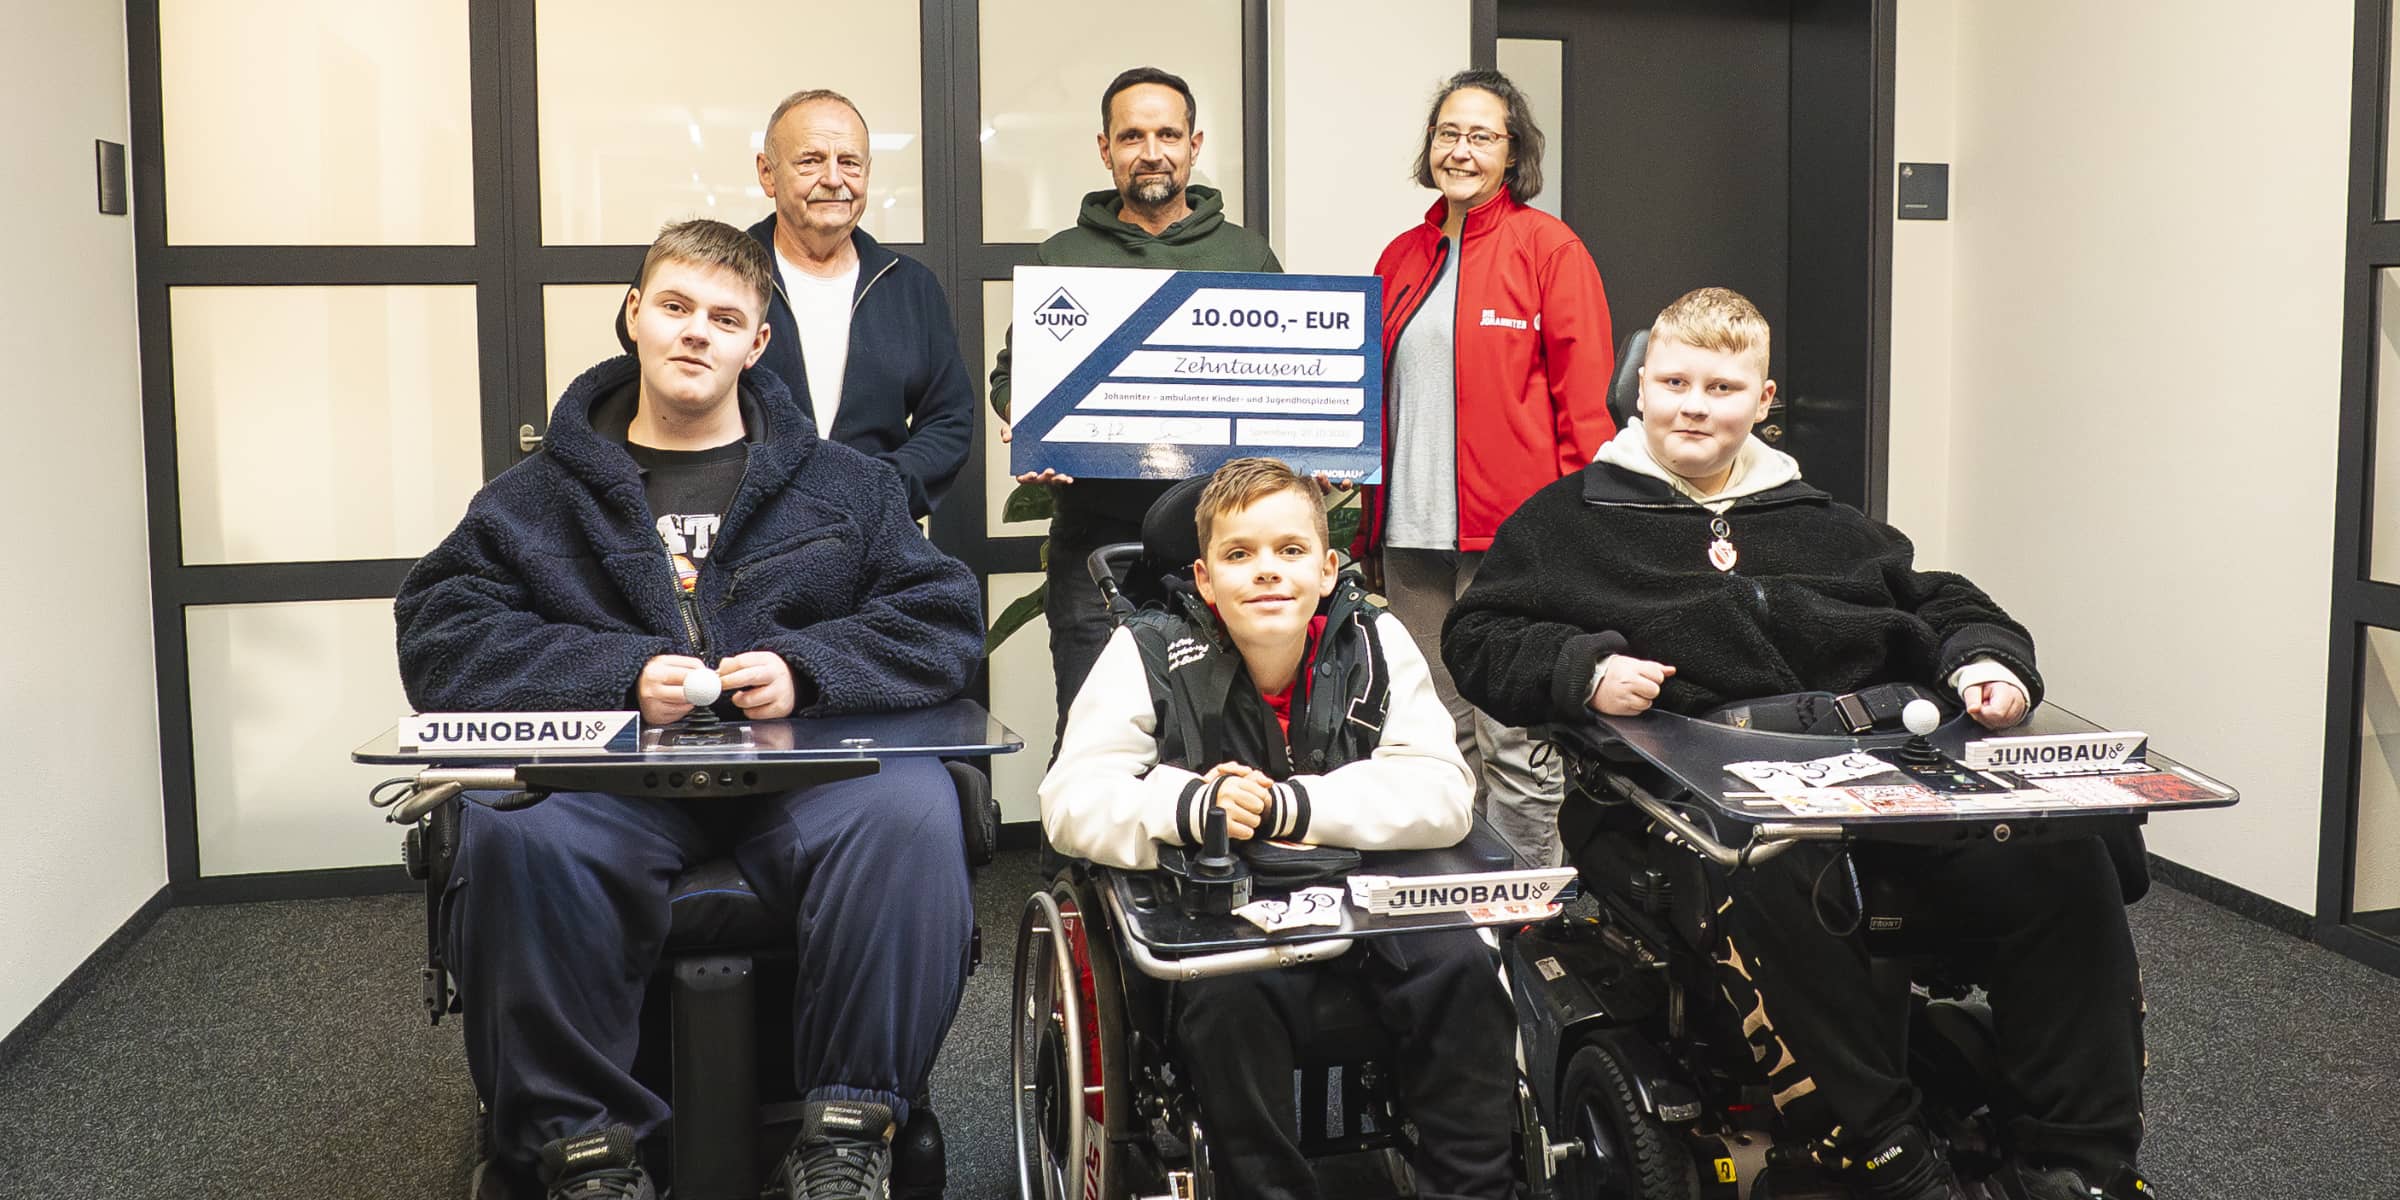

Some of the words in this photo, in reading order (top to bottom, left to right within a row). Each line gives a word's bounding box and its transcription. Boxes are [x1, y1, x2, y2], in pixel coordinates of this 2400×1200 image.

[1035, 313, 1087, 327] JUNO
[1191, 308, 1297, 332] 10.000,-
[1306, 311, 1350, 330] EUR
[1174, 356, 1327, 377] Zehntausend
[1104, 391, 1151, 401] Johanniter
[1160, 393, 1209, 402] ambulanter
[1247, 396, 1264, 404] und
[1266, 396, 1350, 407] Jugendhospizdienst
